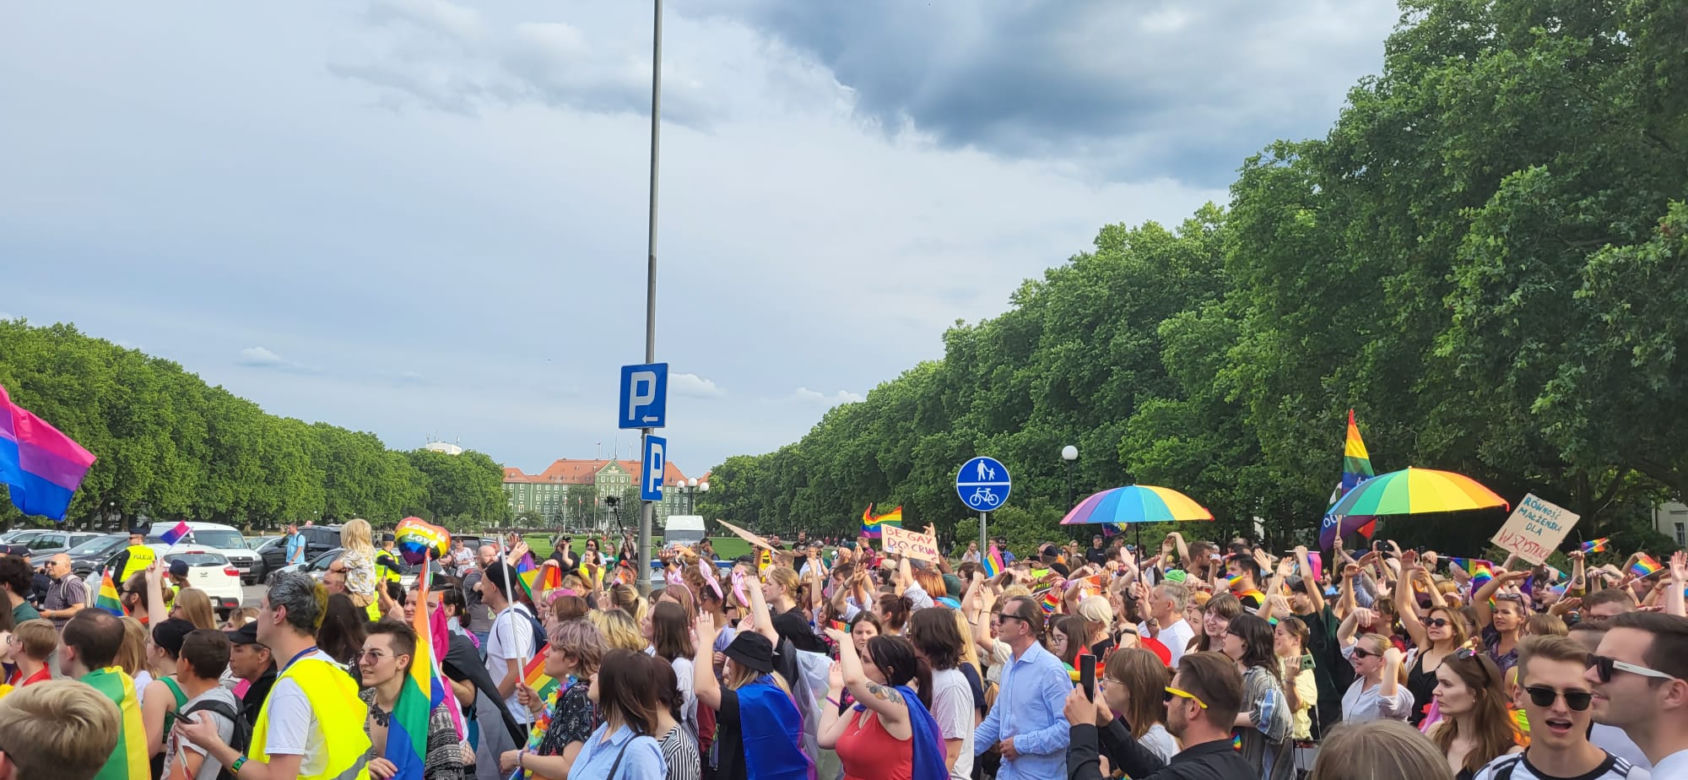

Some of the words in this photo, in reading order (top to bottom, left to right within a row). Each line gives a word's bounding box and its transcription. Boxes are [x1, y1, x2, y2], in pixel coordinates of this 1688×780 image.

[628, 370, 657, 421] P
[648, 442, 664, 493] P
[886, 526, 902, 538] BE
[907, 532, 932, 545] GAY
[1525, 523, 1543, 536] DLA
